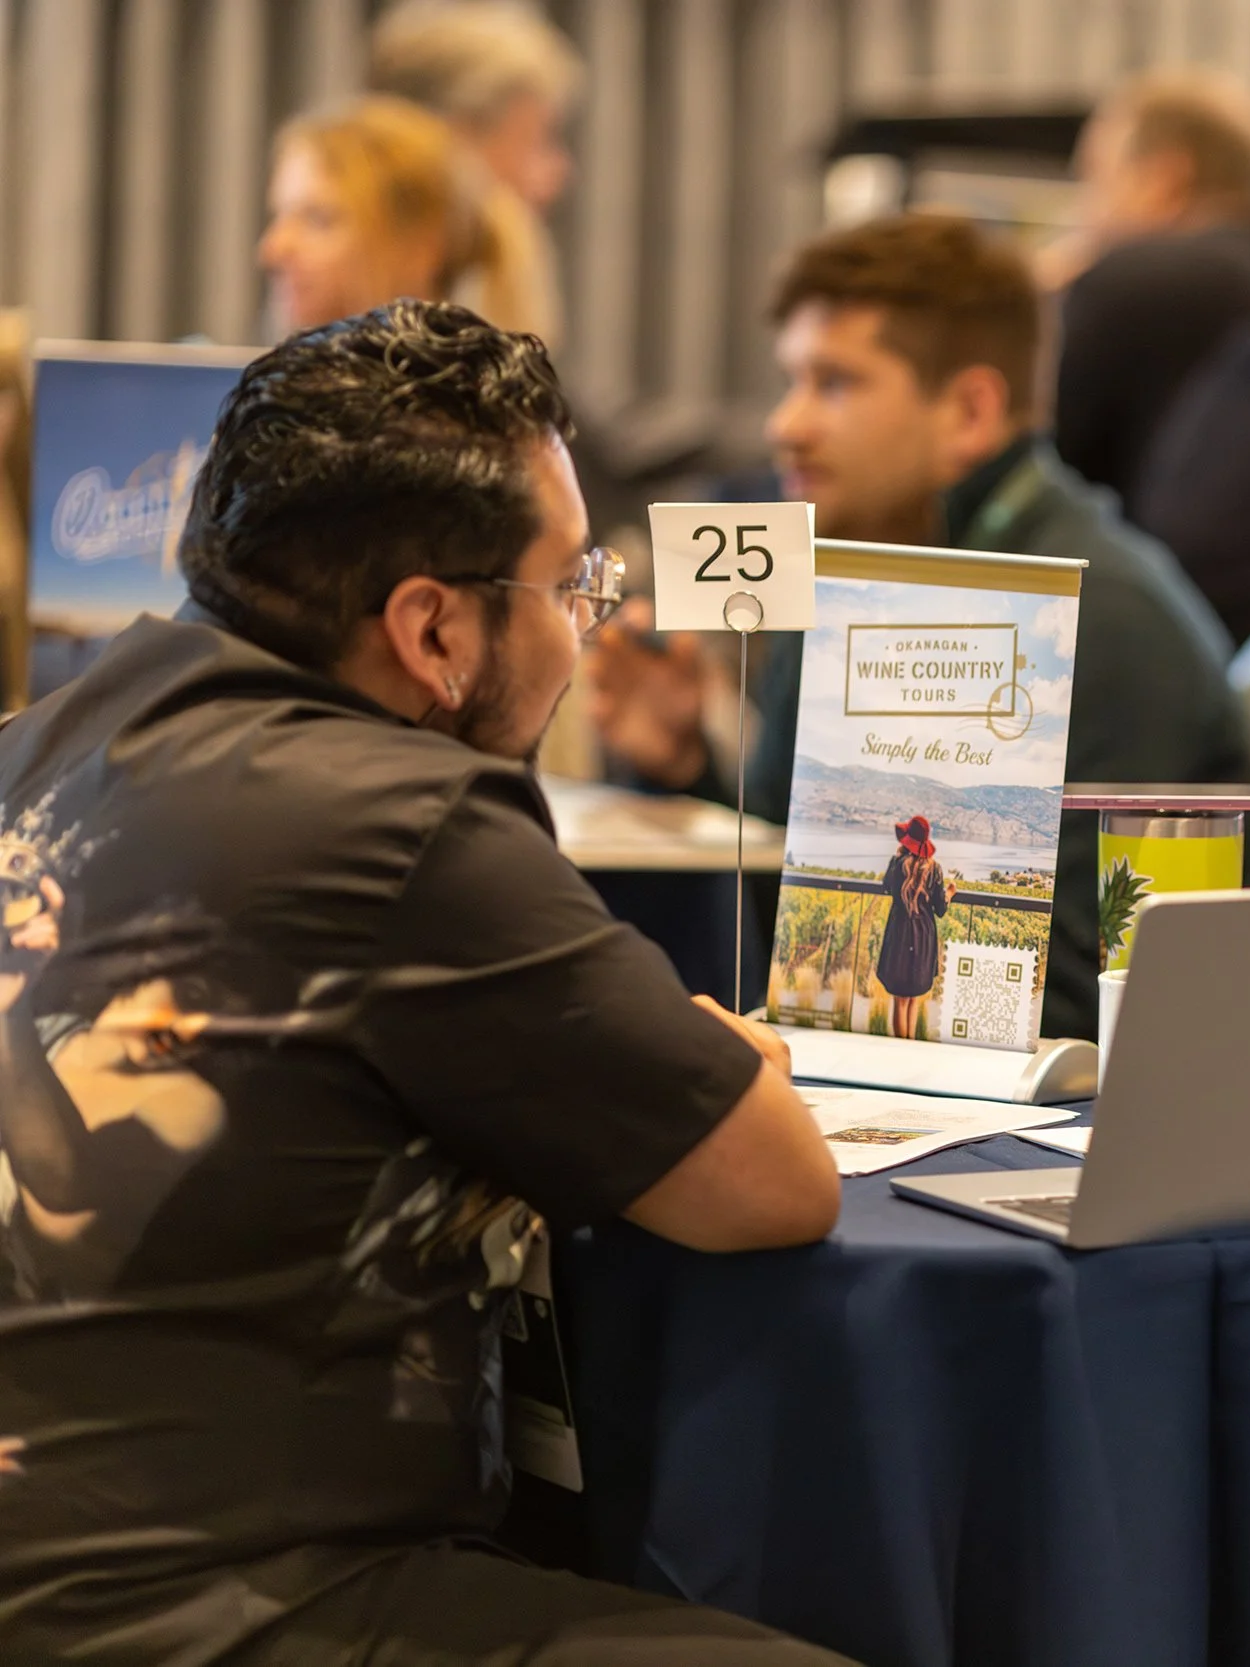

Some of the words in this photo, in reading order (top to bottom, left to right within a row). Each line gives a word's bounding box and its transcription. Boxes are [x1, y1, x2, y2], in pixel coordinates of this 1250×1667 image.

[692, 524, 774, 582] 25
[895, 639, 968, 652] OKANAGAN
[857, 661, 906, 680] WINE
[911, 661, 1004, 680] COUNTRY
[900, 688, 956, 702] TOURS
[861, 732, 918, 764] Simply
[924, 738, 950, 762] the
[955, 741, 993, 766] Best
